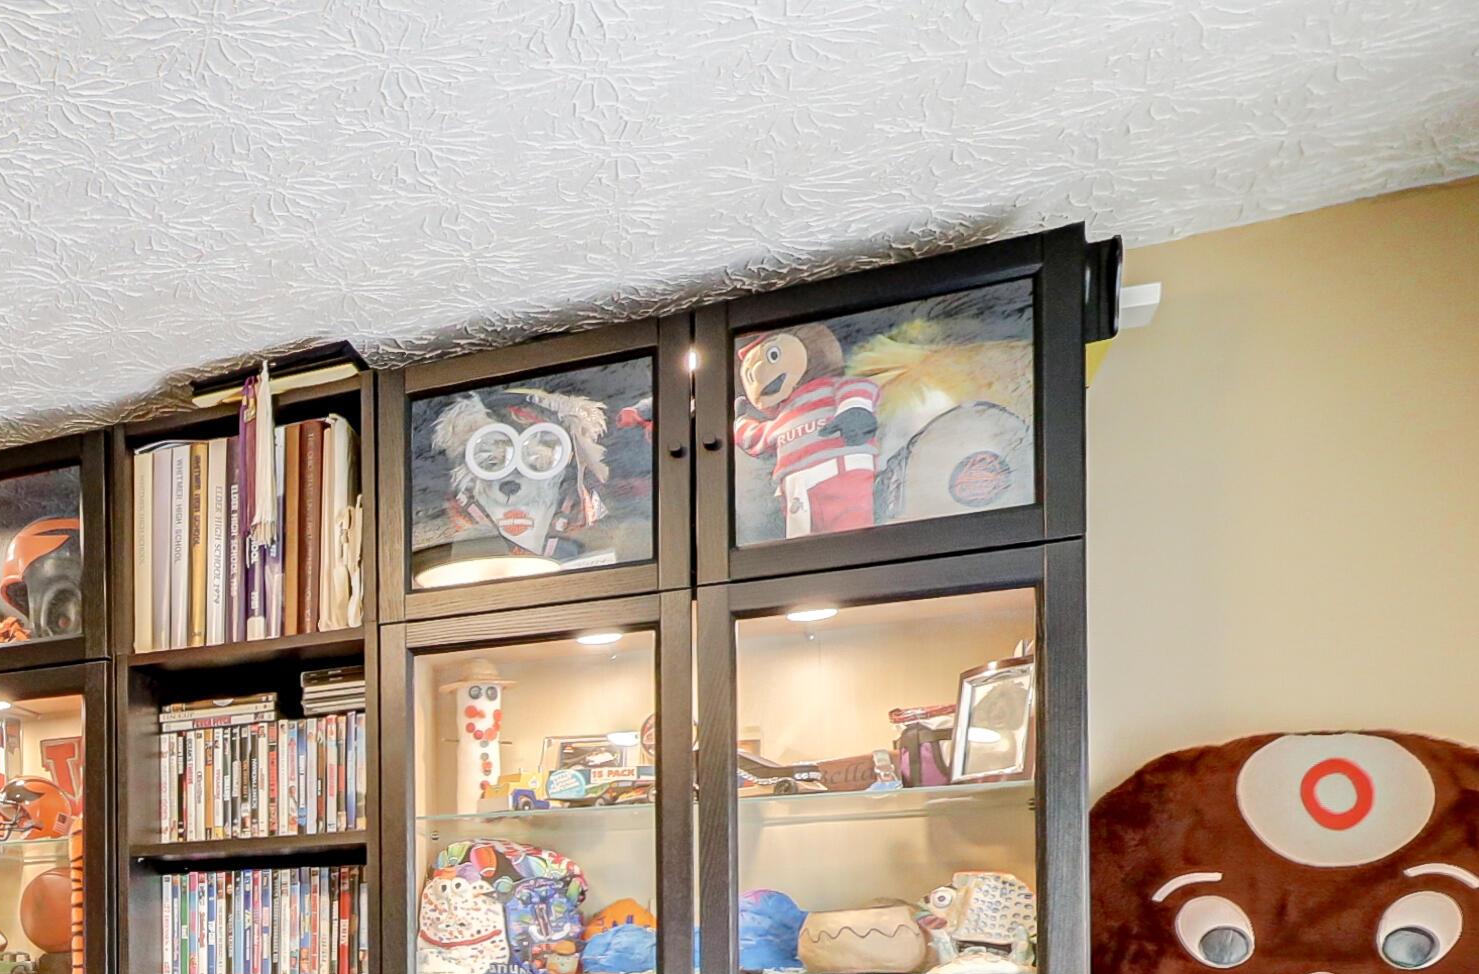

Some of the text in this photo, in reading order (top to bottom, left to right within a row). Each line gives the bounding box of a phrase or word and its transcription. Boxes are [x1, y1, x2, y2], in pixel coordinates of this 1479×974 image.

[776, 419, 826, 445] RUTUS
[174, 458, 184, 565] WHITMER HIGH SCHOOL
[214, 516, 222, 540] HIGH
[213, 543, 222, 581] SCHOOL
[607, 768, 635, 778] PACK
